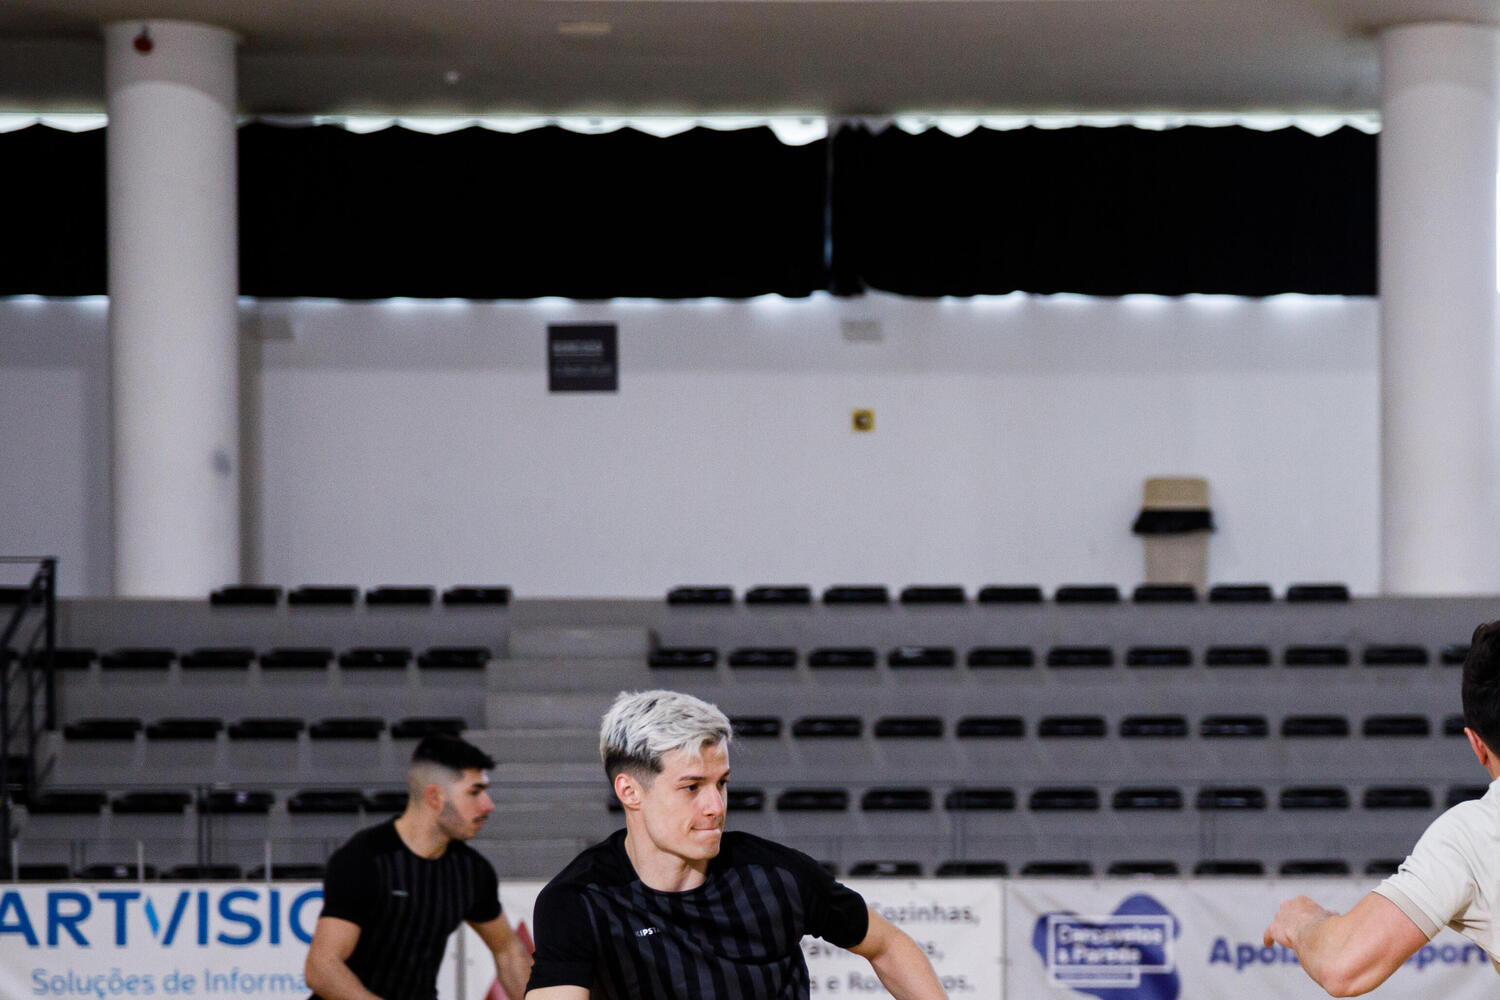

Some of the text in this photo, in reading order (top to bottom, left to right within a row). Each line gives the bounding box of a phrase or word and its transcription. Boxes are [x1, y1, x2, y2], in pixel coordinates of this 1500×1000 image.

[0, 888, 324, 947] ARTVISIO
[1208, 936, 1299, 970] Apoi
[31, 966, 311, 1000] Soluções de Informa
